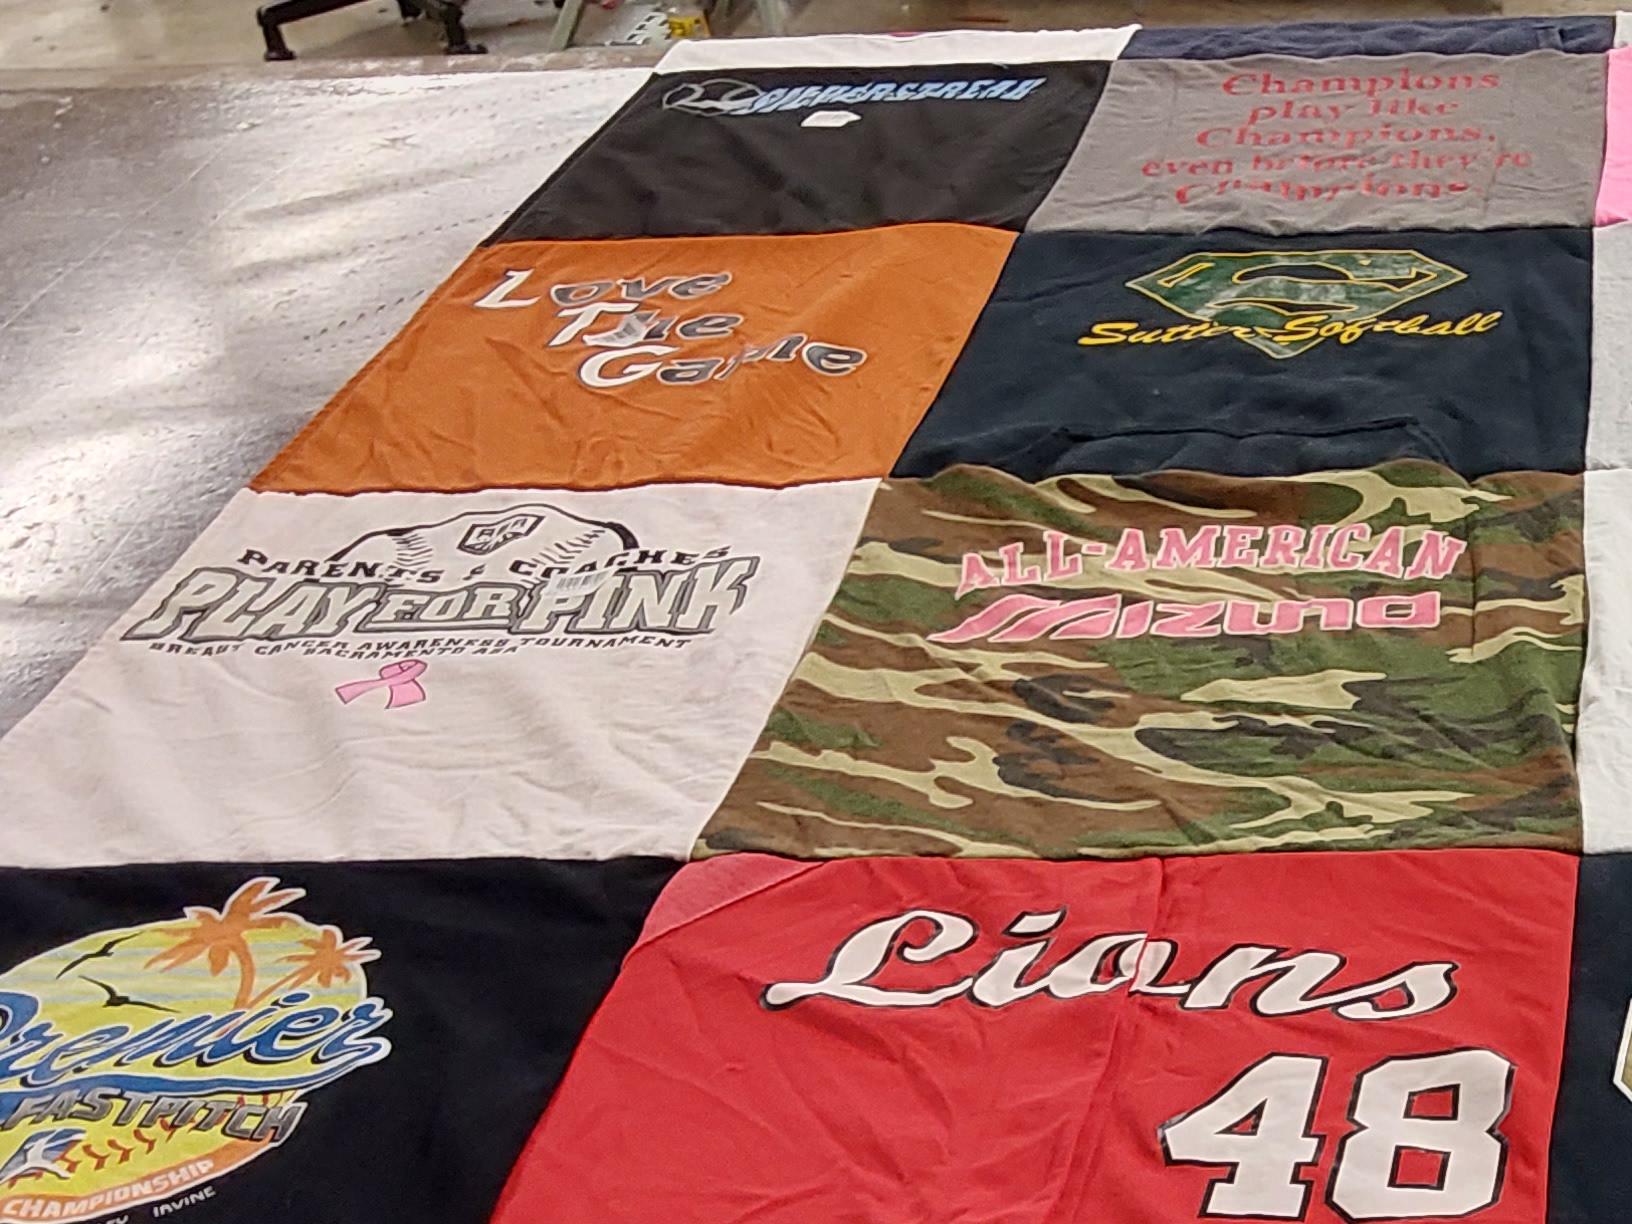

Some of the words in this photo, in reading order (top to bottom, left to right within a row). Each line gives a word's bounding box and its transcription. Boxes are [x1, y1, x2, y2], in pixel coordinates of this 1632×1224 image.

[1222, 68, 1499, 97] Champions
[1248, 99, 1354, 125] play
[1369, 97, 1459, 115] like
[1141, 160, 1234, 177] even
[473, 268, 731, 308] Love
[547, 302, 743, 347] The
[955, 522, 1467, 599] ALL-AMERICAN
[121, 566, 384, 641] PLAY
[370, 578, 526, 634] FOR
[510, 556, 760, 638] PINK
[254, 640, 349, 656] CANCER
[520, 635, 693, 649] TOURNAMENT
[761, 905, 1461, 1021] Lions
[2, 1086, 308, 1147] FASTPITCH
[3, 1160, 214, 1218] CHAMPIONSHIP
[153, 1186, 217, 1218] IRVINE
